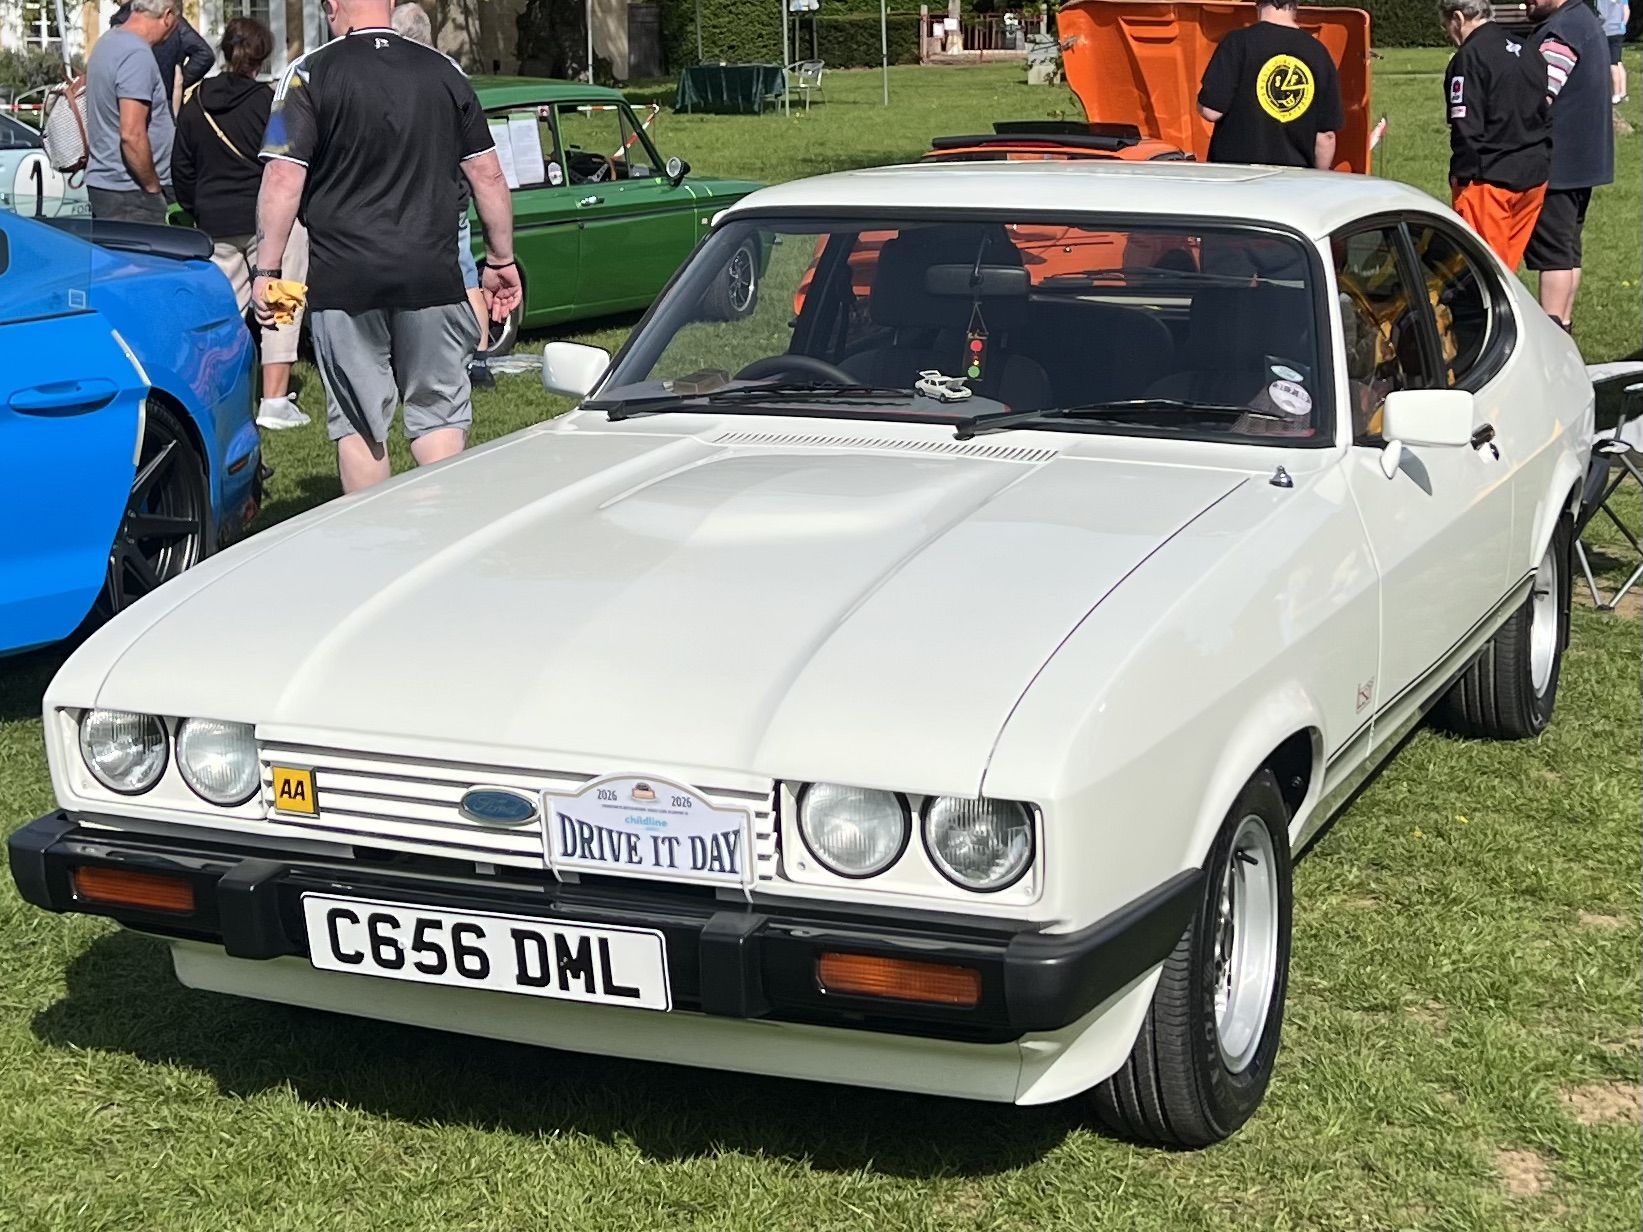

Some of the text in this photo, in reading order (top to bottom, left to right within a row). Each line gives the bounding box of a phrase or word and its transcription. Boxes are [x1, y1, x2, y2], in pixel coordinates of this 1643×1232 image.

[29, 158, 47, 217] 1
[279, 778, 305, 801] AA
[597, 788, 618, 801] 2026
[671, 795, 692, 808] 2026
[624, 814, 668, 828] childline
[556, 811, 741, 875] DRIVE IT DAY
[326, 907, 641, 999] C656 DML
